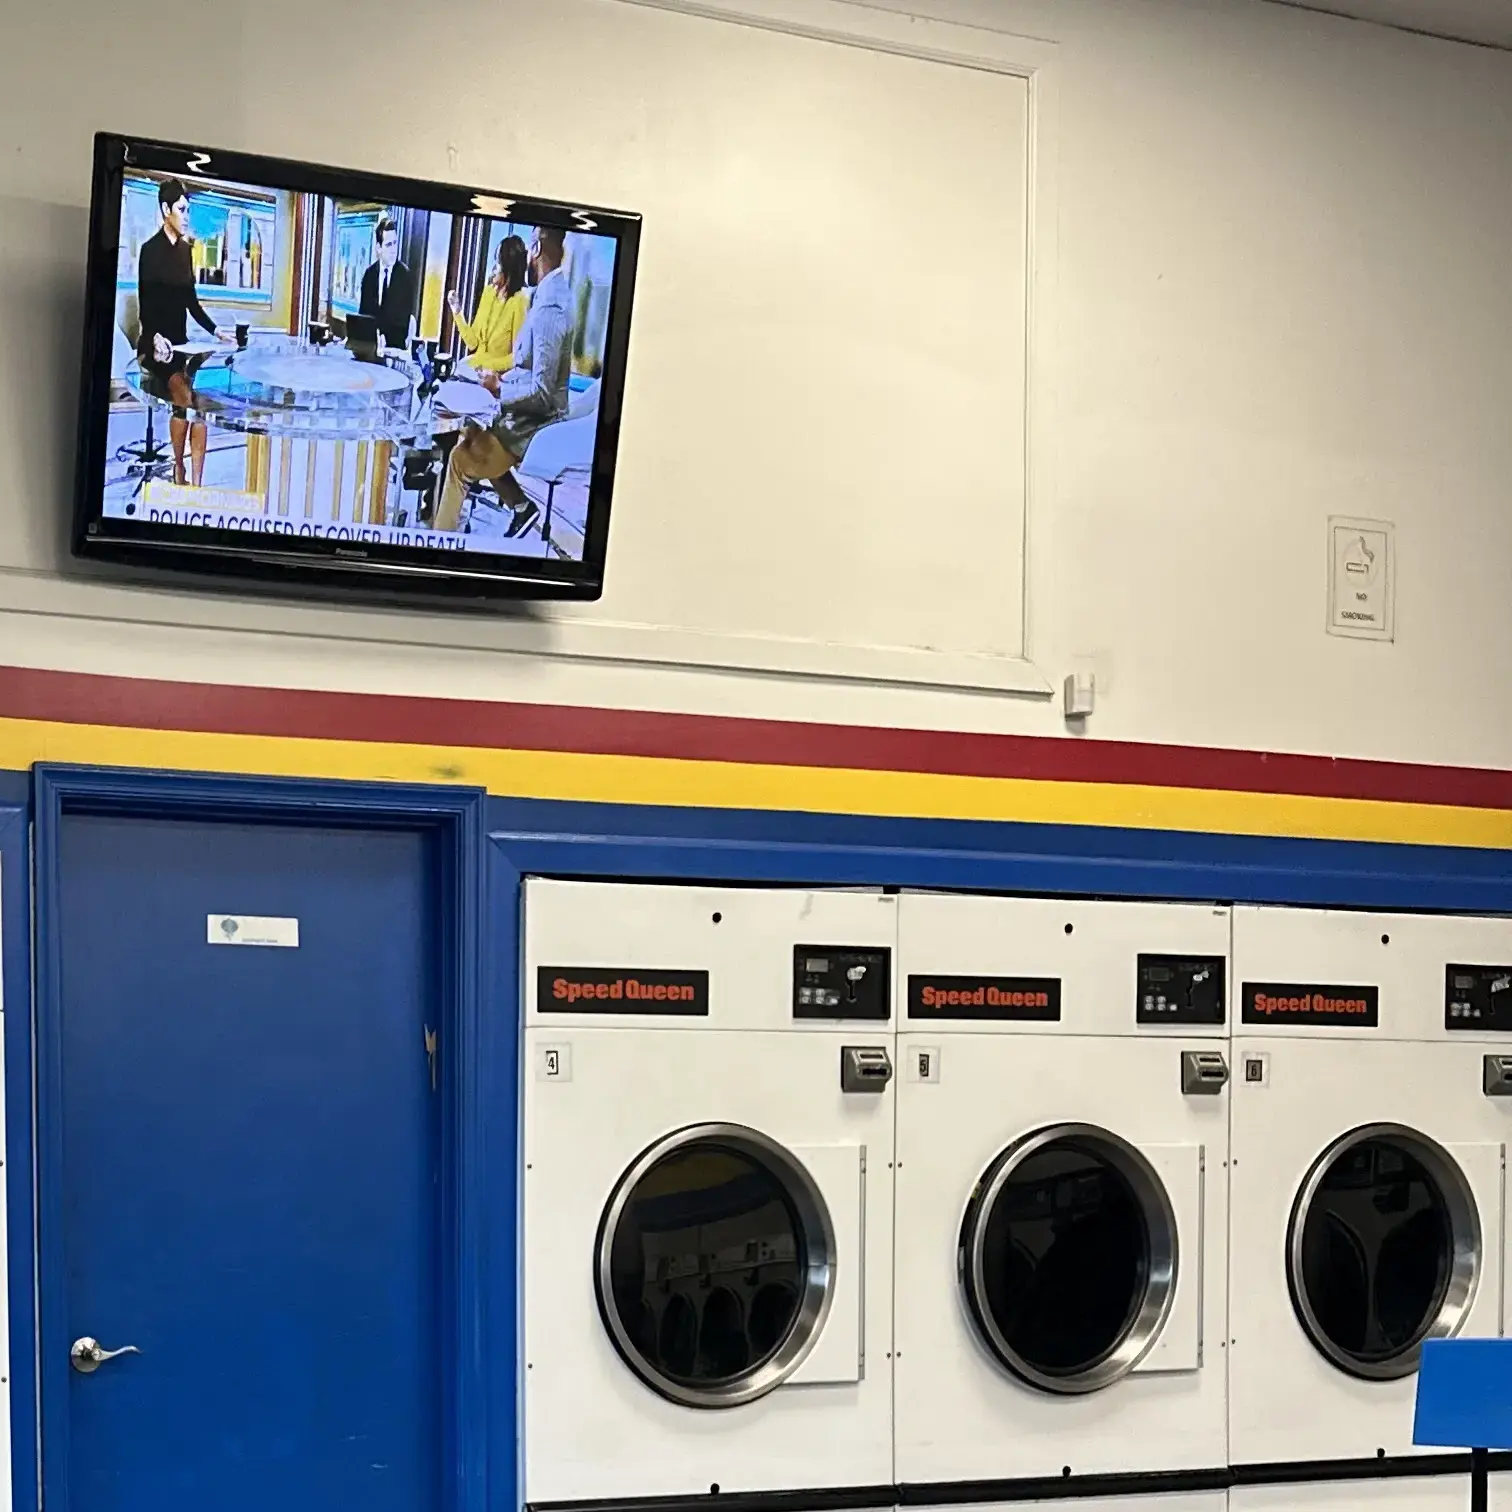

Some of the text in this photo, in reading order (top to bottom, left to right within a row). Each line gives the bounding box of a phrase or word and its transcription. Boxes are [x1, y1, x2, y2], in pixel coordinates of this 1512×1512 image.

[1356, 592, 1368, 600] NO
[553, 978, 695, 1003] Speed Queen
[921, 986, 1049, 1007] Speed Queen
[1254, 994, 1367, 1014] Speed Queen
[548, 1056, 555, 1070] 4
